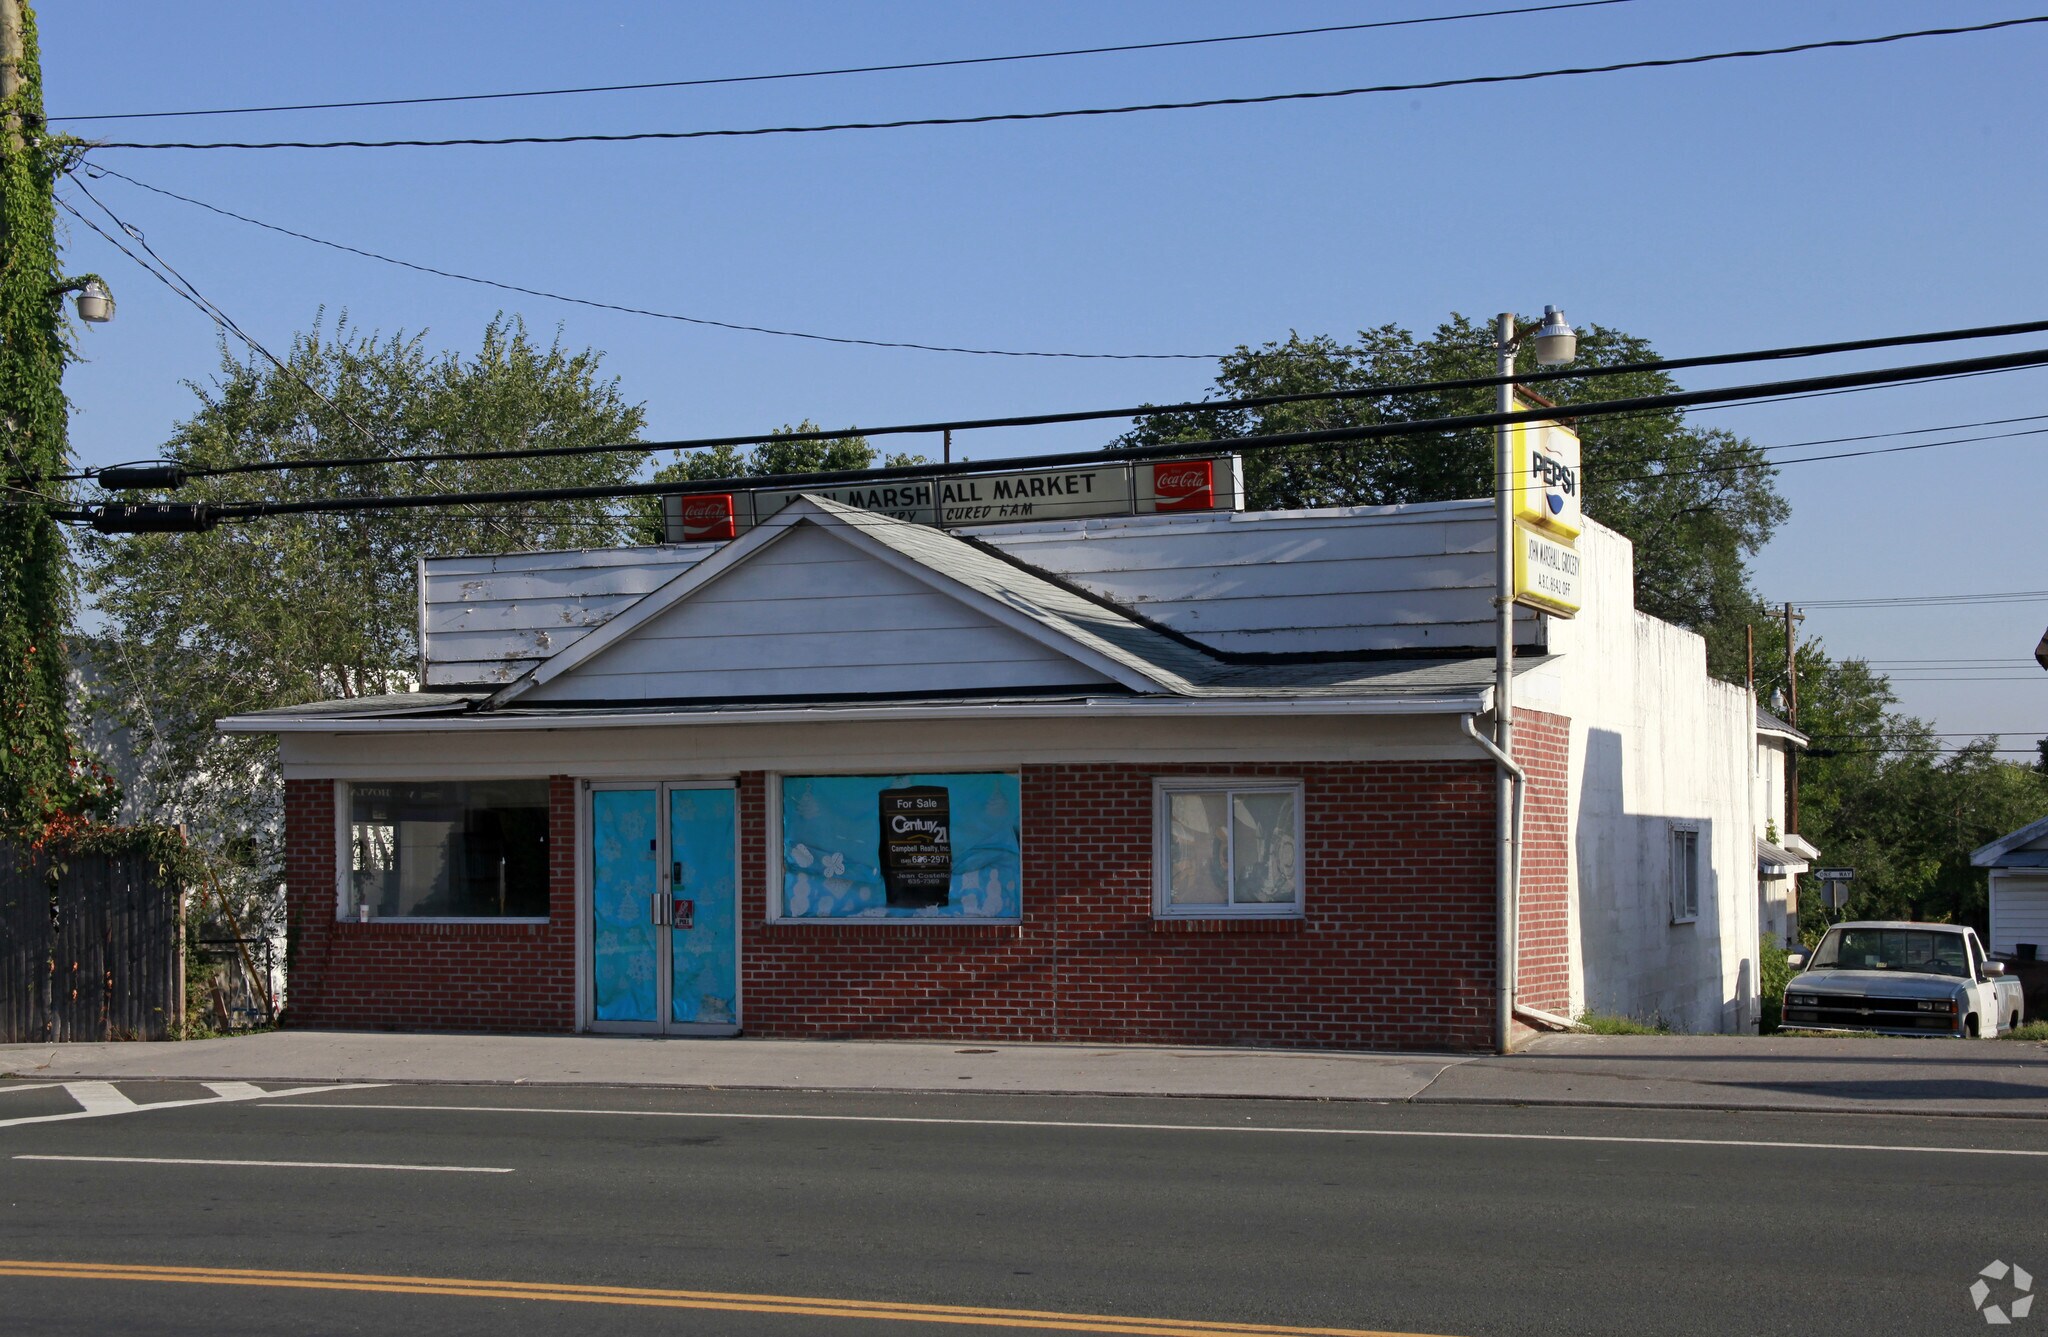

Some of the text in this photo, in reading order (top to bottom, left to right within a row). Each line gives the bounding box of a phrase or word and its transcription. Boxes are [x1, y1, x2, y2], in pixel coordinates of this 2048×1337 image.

[1157, 471, 1205, 489] Coca-Cola
[1533, 450, 1575, 497] PEPSI
[993, 473, 1096, 499] MARKET
[685, 503, 726, 520] Coca-Cola
[946, 503, 1033, 521] CURED HAM
[1528, 538, 1580, 578] JOHN MARSHALL GROCERY
[897, 798, 937, 809] For Sale
[892, 815, 948, 843] Century 21
[891, 845, 918, 853] Campbell
